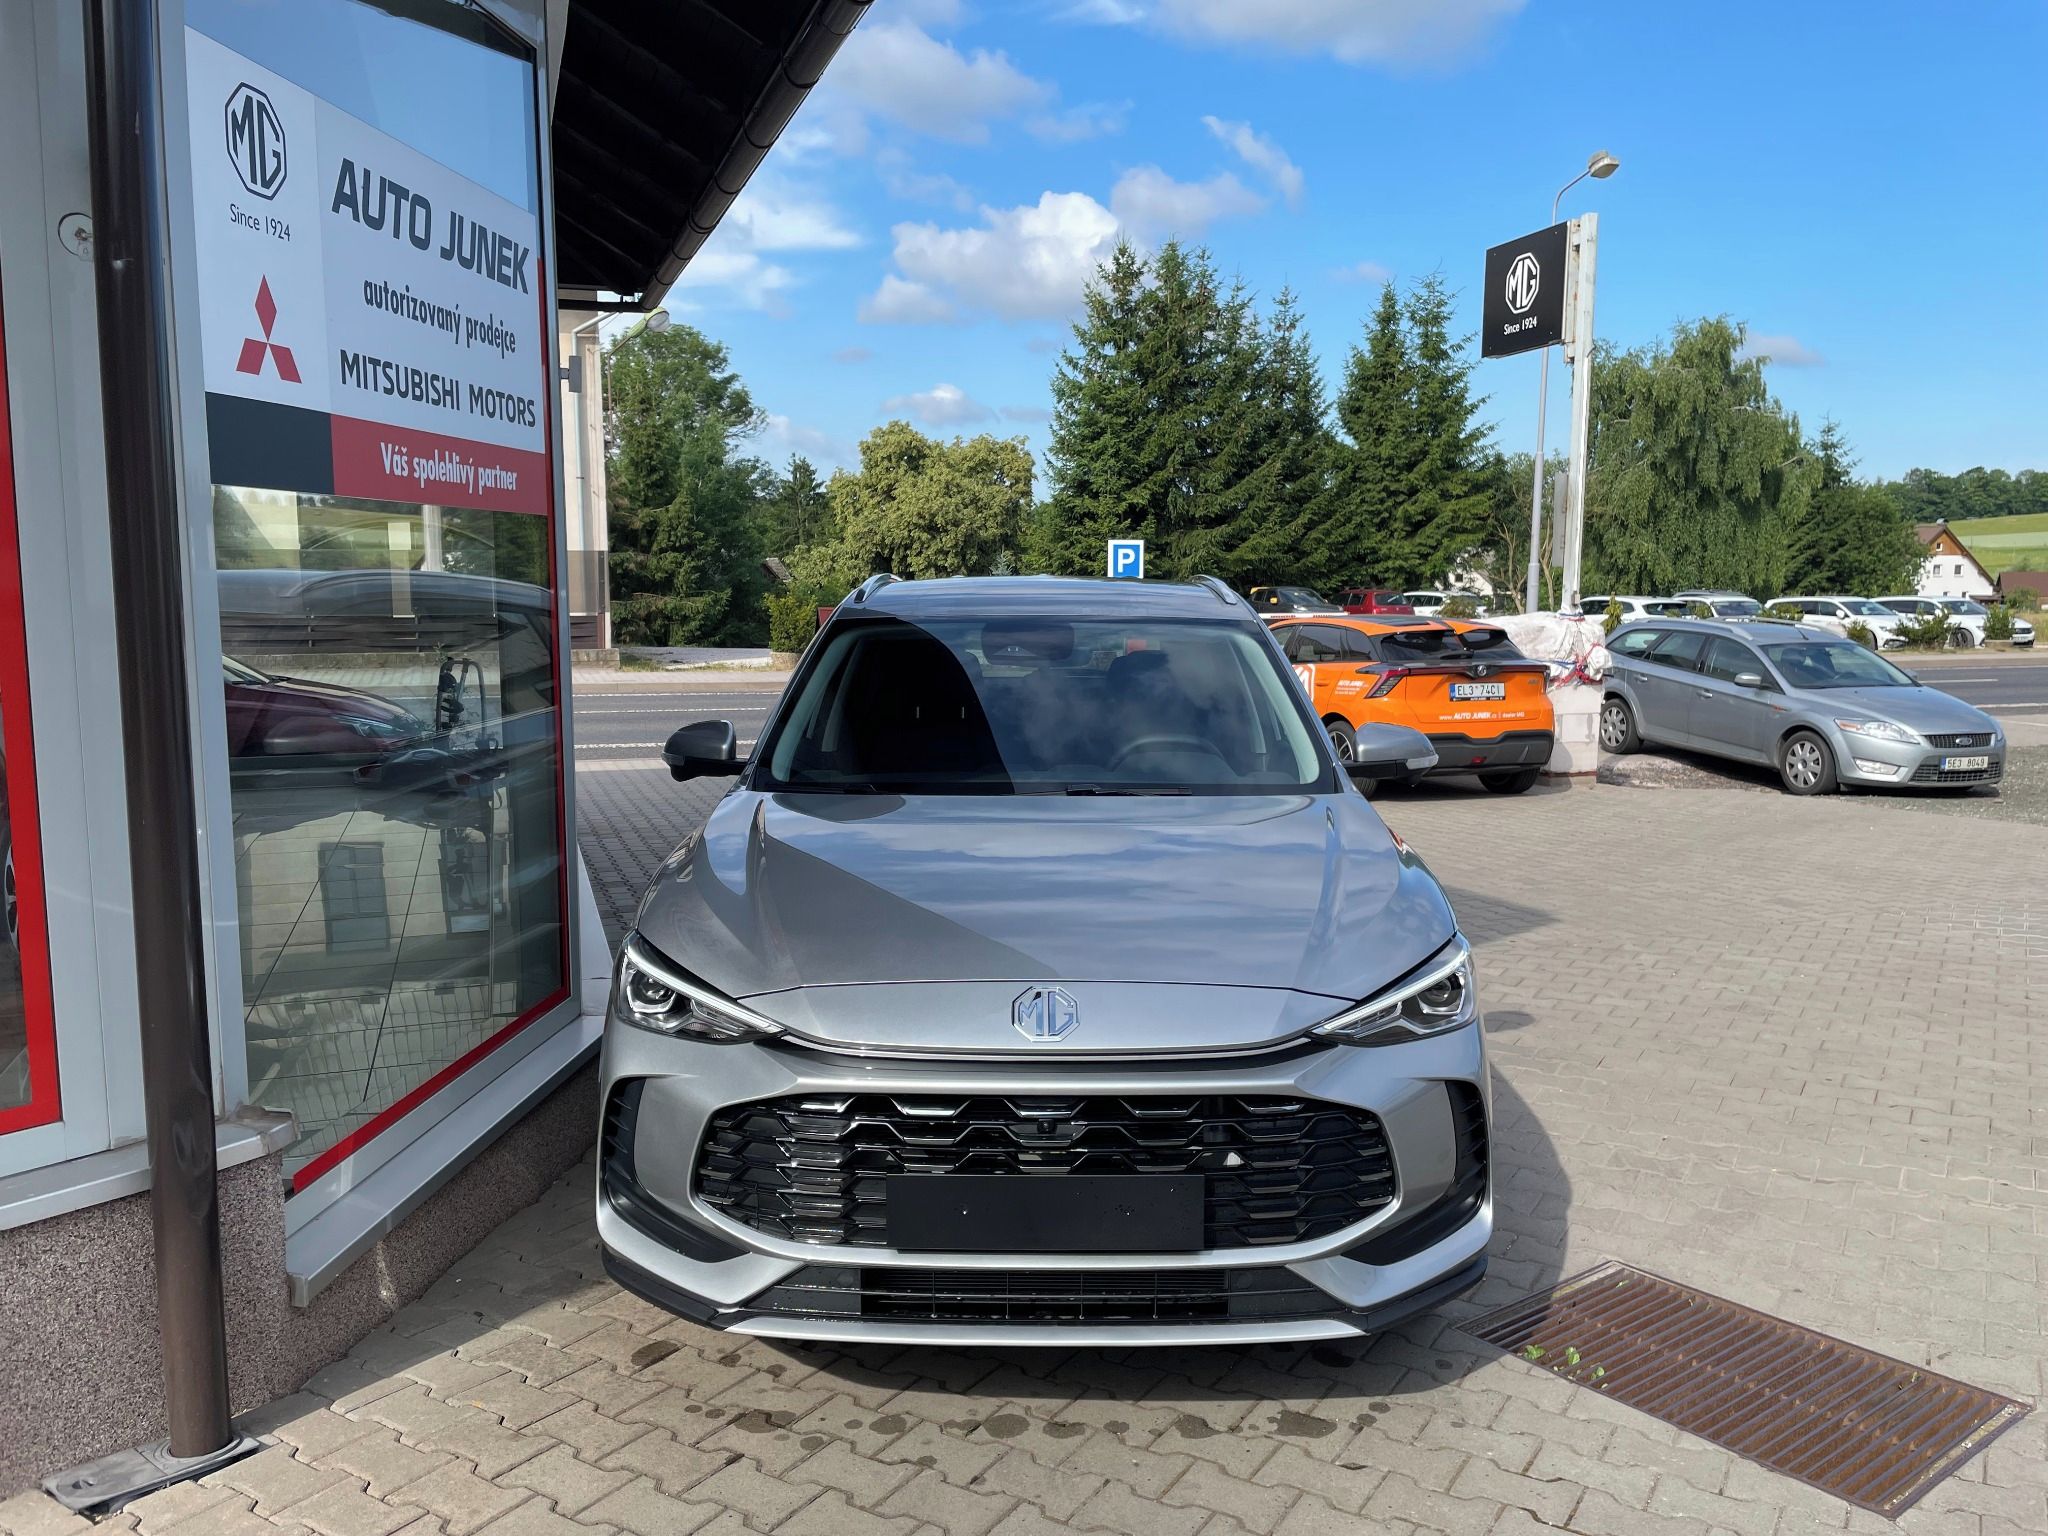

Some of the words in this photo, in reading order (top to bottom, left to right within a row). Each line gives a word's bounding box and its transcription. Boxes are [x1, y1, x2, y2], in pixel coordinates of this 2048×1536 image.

[231, 94, 281, 190] MG
[229, 203, 260, 231] Since
[265, 215, 291, 242] 1924
[331, 157, 432, 251] AUTO
[440, 210, 530, 295] JUNEK
[1508, 258, 1537, 310] MG
[363, 279, 461, 345] autorizovaný
[465, 312, 516, 359] prodejce
[1503, 323, 1520, 335] Since
[1521, 316, 1538, 331] 1924
[340, 349, 461, 411] MITSUBISHI
[468, 383, 536, 428] MOTORS
[380, 442, 409, 477] Váš
[412, 449, 475, 494] spolehlivý
[478, 465, 518, 495] partner
[1117, 548, 1136, 573] P
[1457, 685, 1474, 696] EL3
[1018, 991, 1073, 1036] MG
